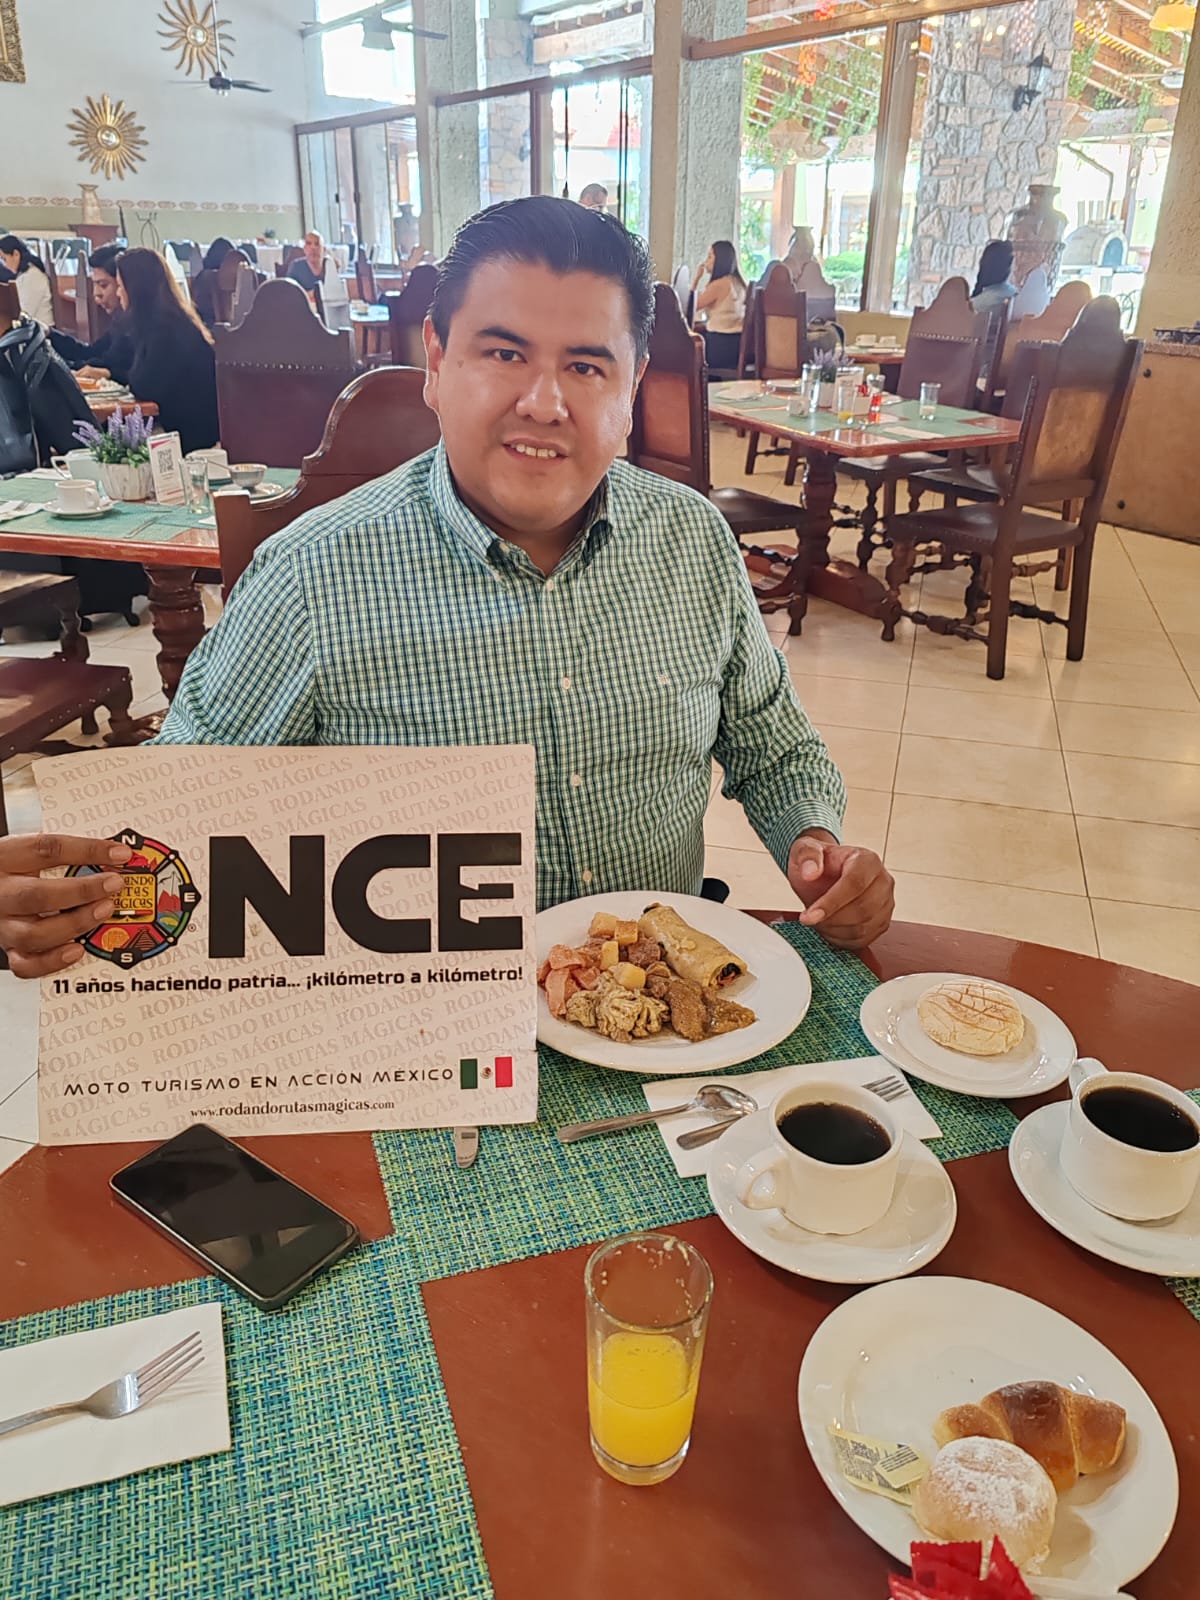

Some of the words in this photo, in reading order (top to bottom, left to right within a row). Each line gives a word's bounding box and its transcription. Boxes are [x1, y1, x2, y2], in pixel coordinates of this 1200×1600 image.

[69, 761, 174, 802] RODANDO
[80, 792, 145, 823] RUTAS
[151, 761, 242, 802] MÁGICAS
[192, 783, 258, 814] RUTAS
[260, 752, 352, 793] MÁGICAS
[269, 772, 370, 813] RODANDO
[374, 754, 436, 783] RUTAS
[275, 794, 366, 835] MÁGICAS
[378, 764, 476, 805] RODANDO
[388, 794, 451, 824] RUTAS
[53, 979, 70, 994] 11
[75, 977, 126, 994] años
[131, 976, 222, 993] haciendo
[228, 974, 301, 992] patria...
[306, 968, 405, 990] ¡kilómetro
[410, 971, 422, 984] a
[427, 966, 523, 984] kilómetro!
[149, 1007, 215, 1040] RUTAS
[151, 1018, 257, 1063] RODANDO
[261, 995, 326, 1027] RUTAS
[343, 1006, 432, 1049] MÁGICAS
[456, 1002, 515, 1034] RUTAS
[231, 1018, 323, 1061] MÁGICAS
[64, 1082, 130, 1096] MOTO
[142, 1077, 240, 1091] TURISMO
[250, 1076, 278, 1089] EN
[288, 1070, 363, 1087] ACCIÓN
[190, 1098, 395, 1117] www.rodandorutasmagicas.com
